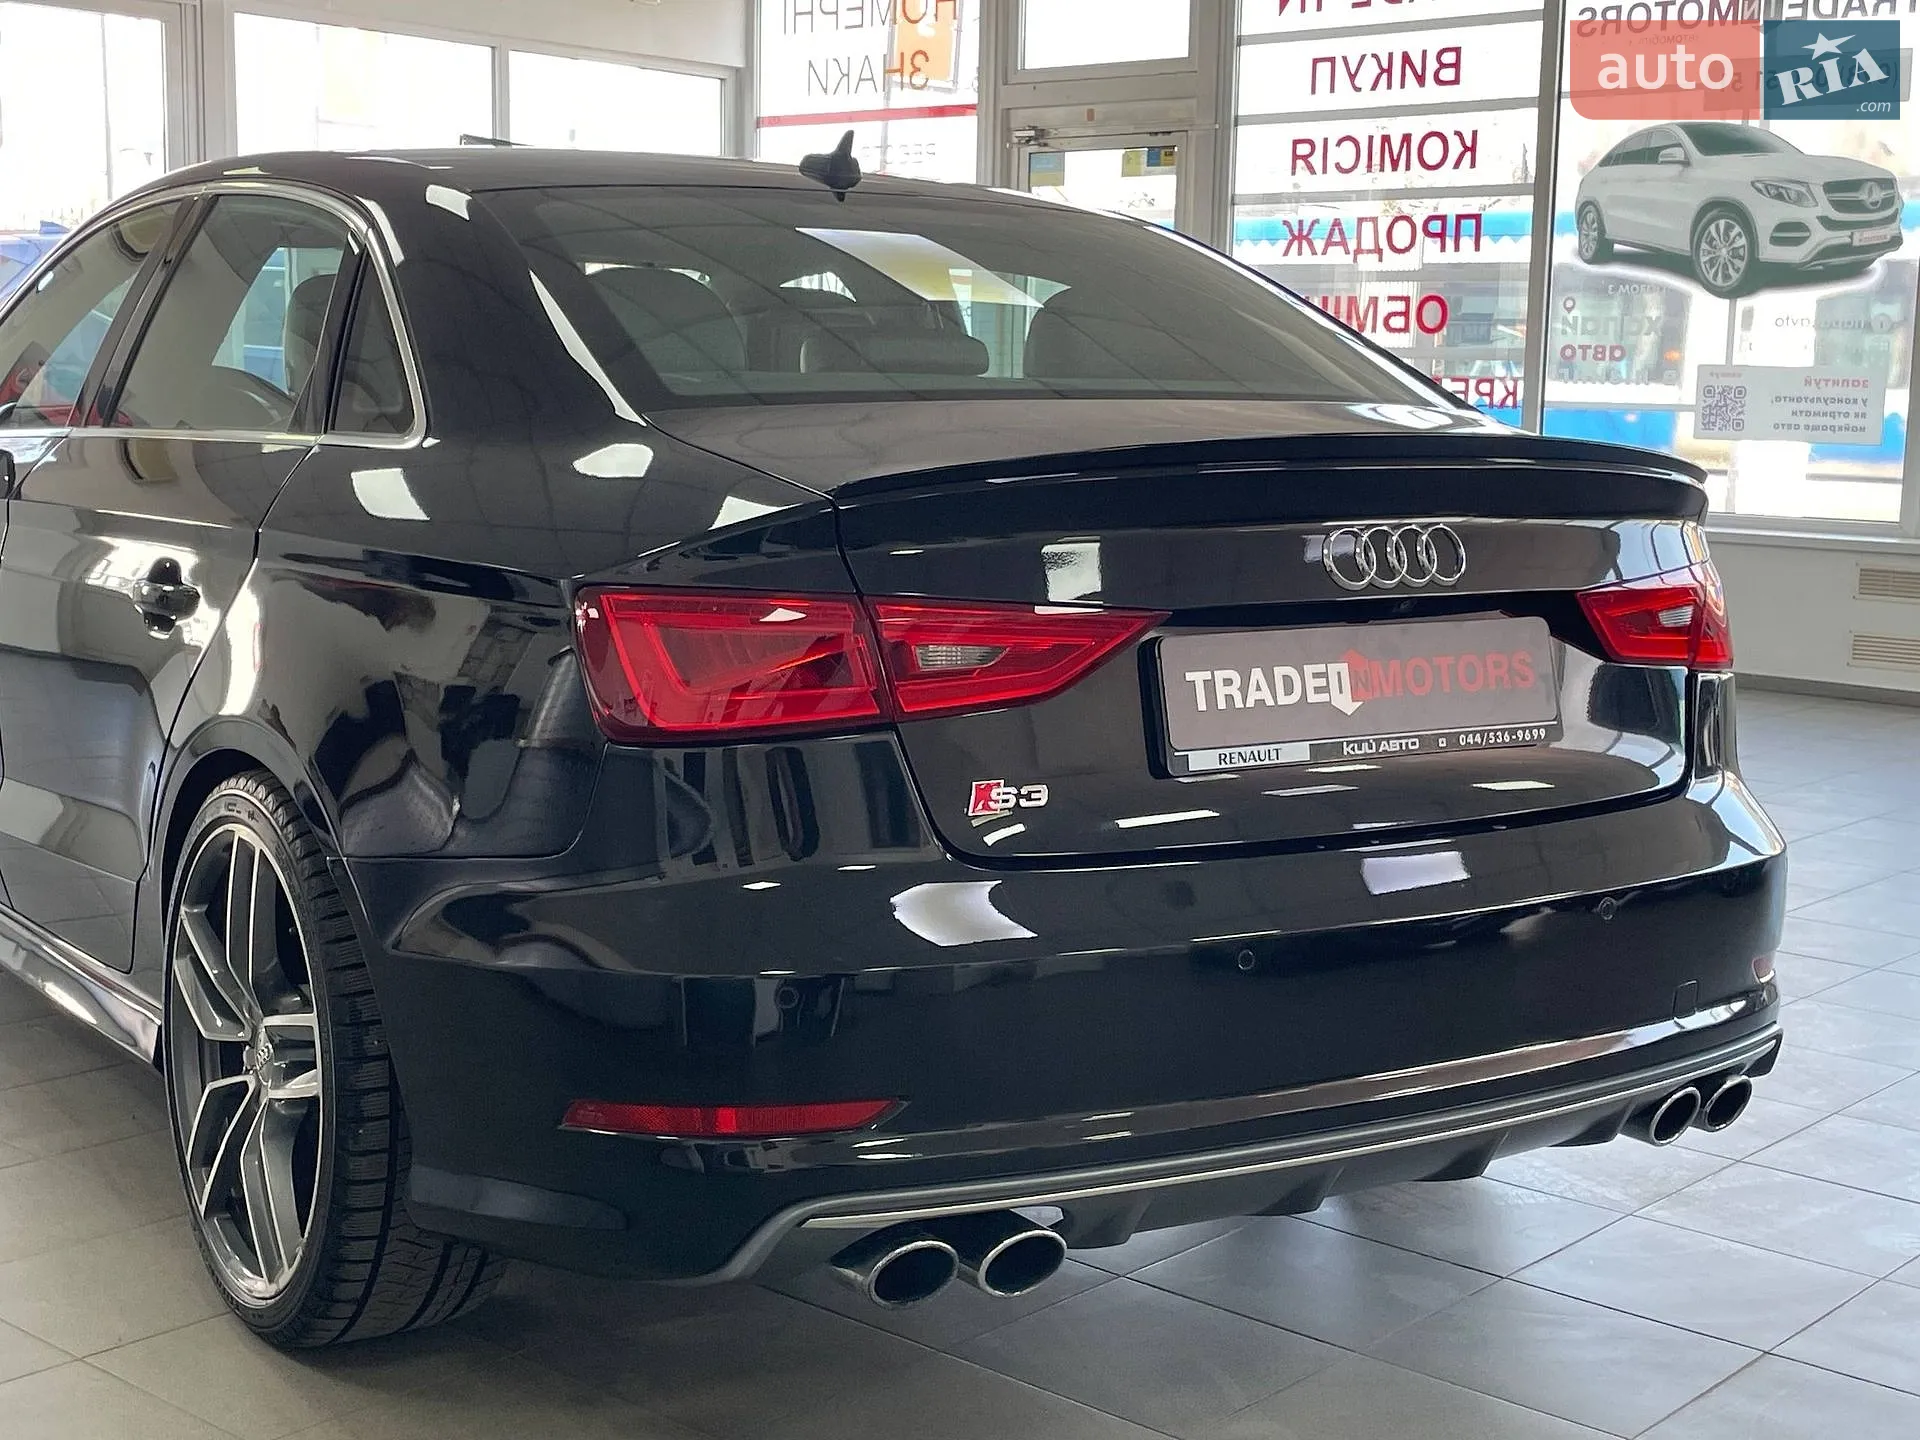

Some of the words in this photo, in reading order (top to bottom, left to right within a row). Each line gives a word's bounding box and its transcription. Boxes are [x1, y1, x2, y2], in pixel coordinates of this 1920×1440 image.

[1459, 728, 1546, 746] 044/536-9699
[1218, 747, 1282, 765] RENAULT
[986, 784, 1049, 810] S3
